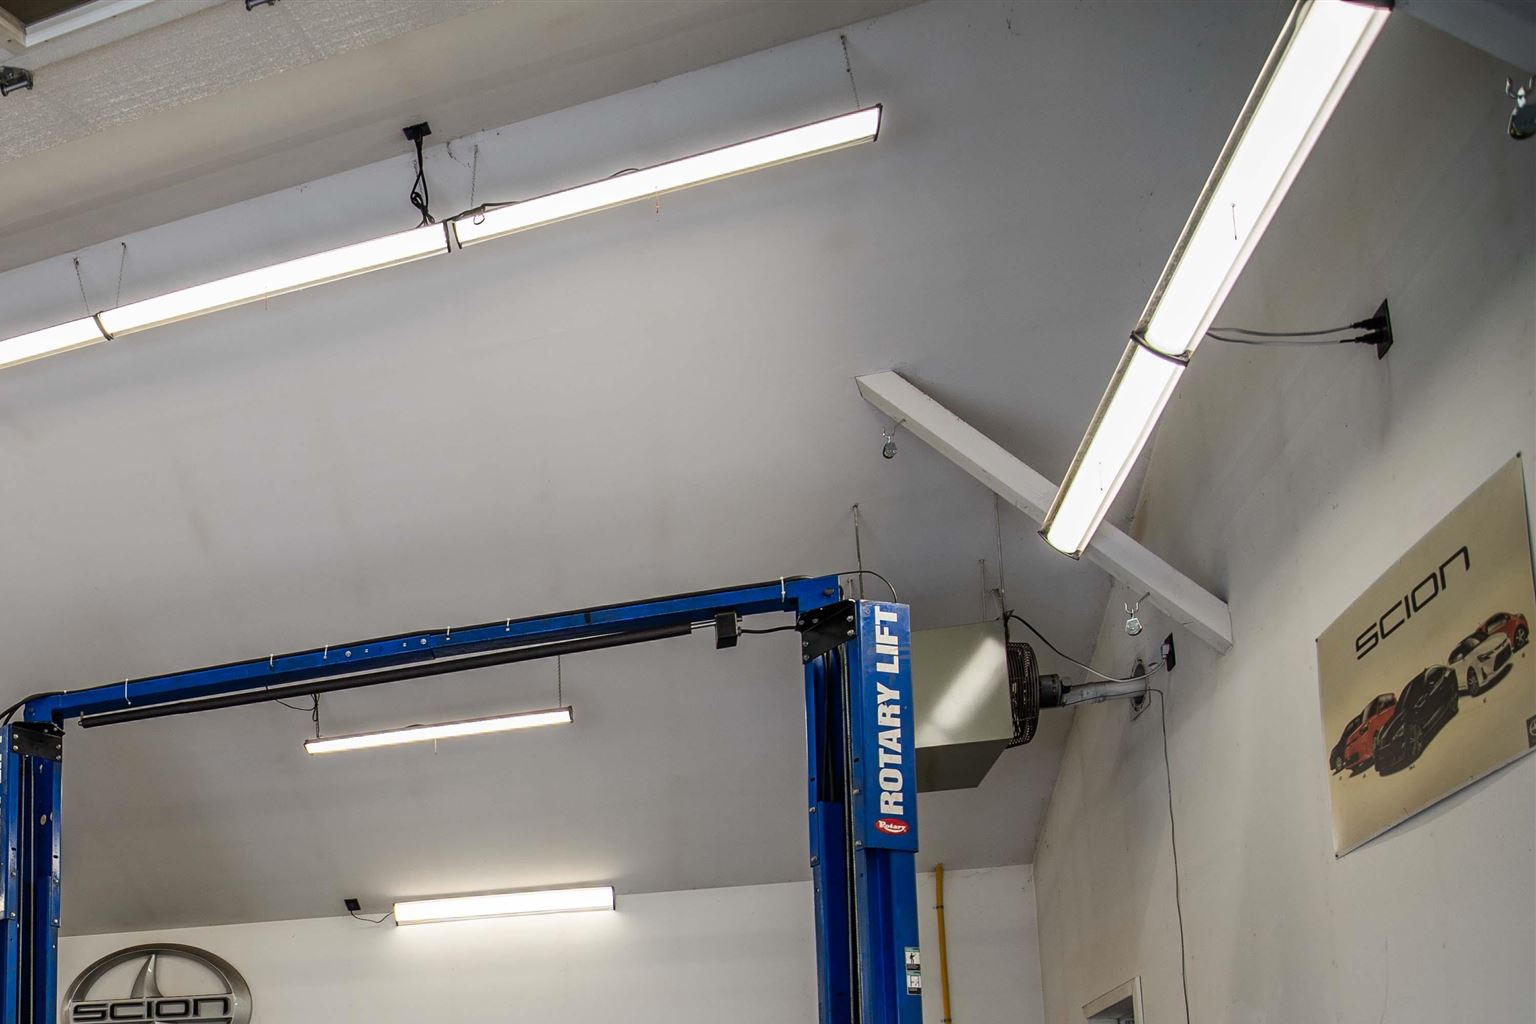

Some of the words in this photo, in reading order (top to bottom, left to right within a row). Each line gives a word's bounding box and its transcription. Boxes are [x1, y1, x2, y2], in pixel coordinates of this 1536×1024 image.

[874, 605, 899, 674] LIFT
[877, 682, 904, 816] ROTARY
[877, 820, 907, 834] Rotary
